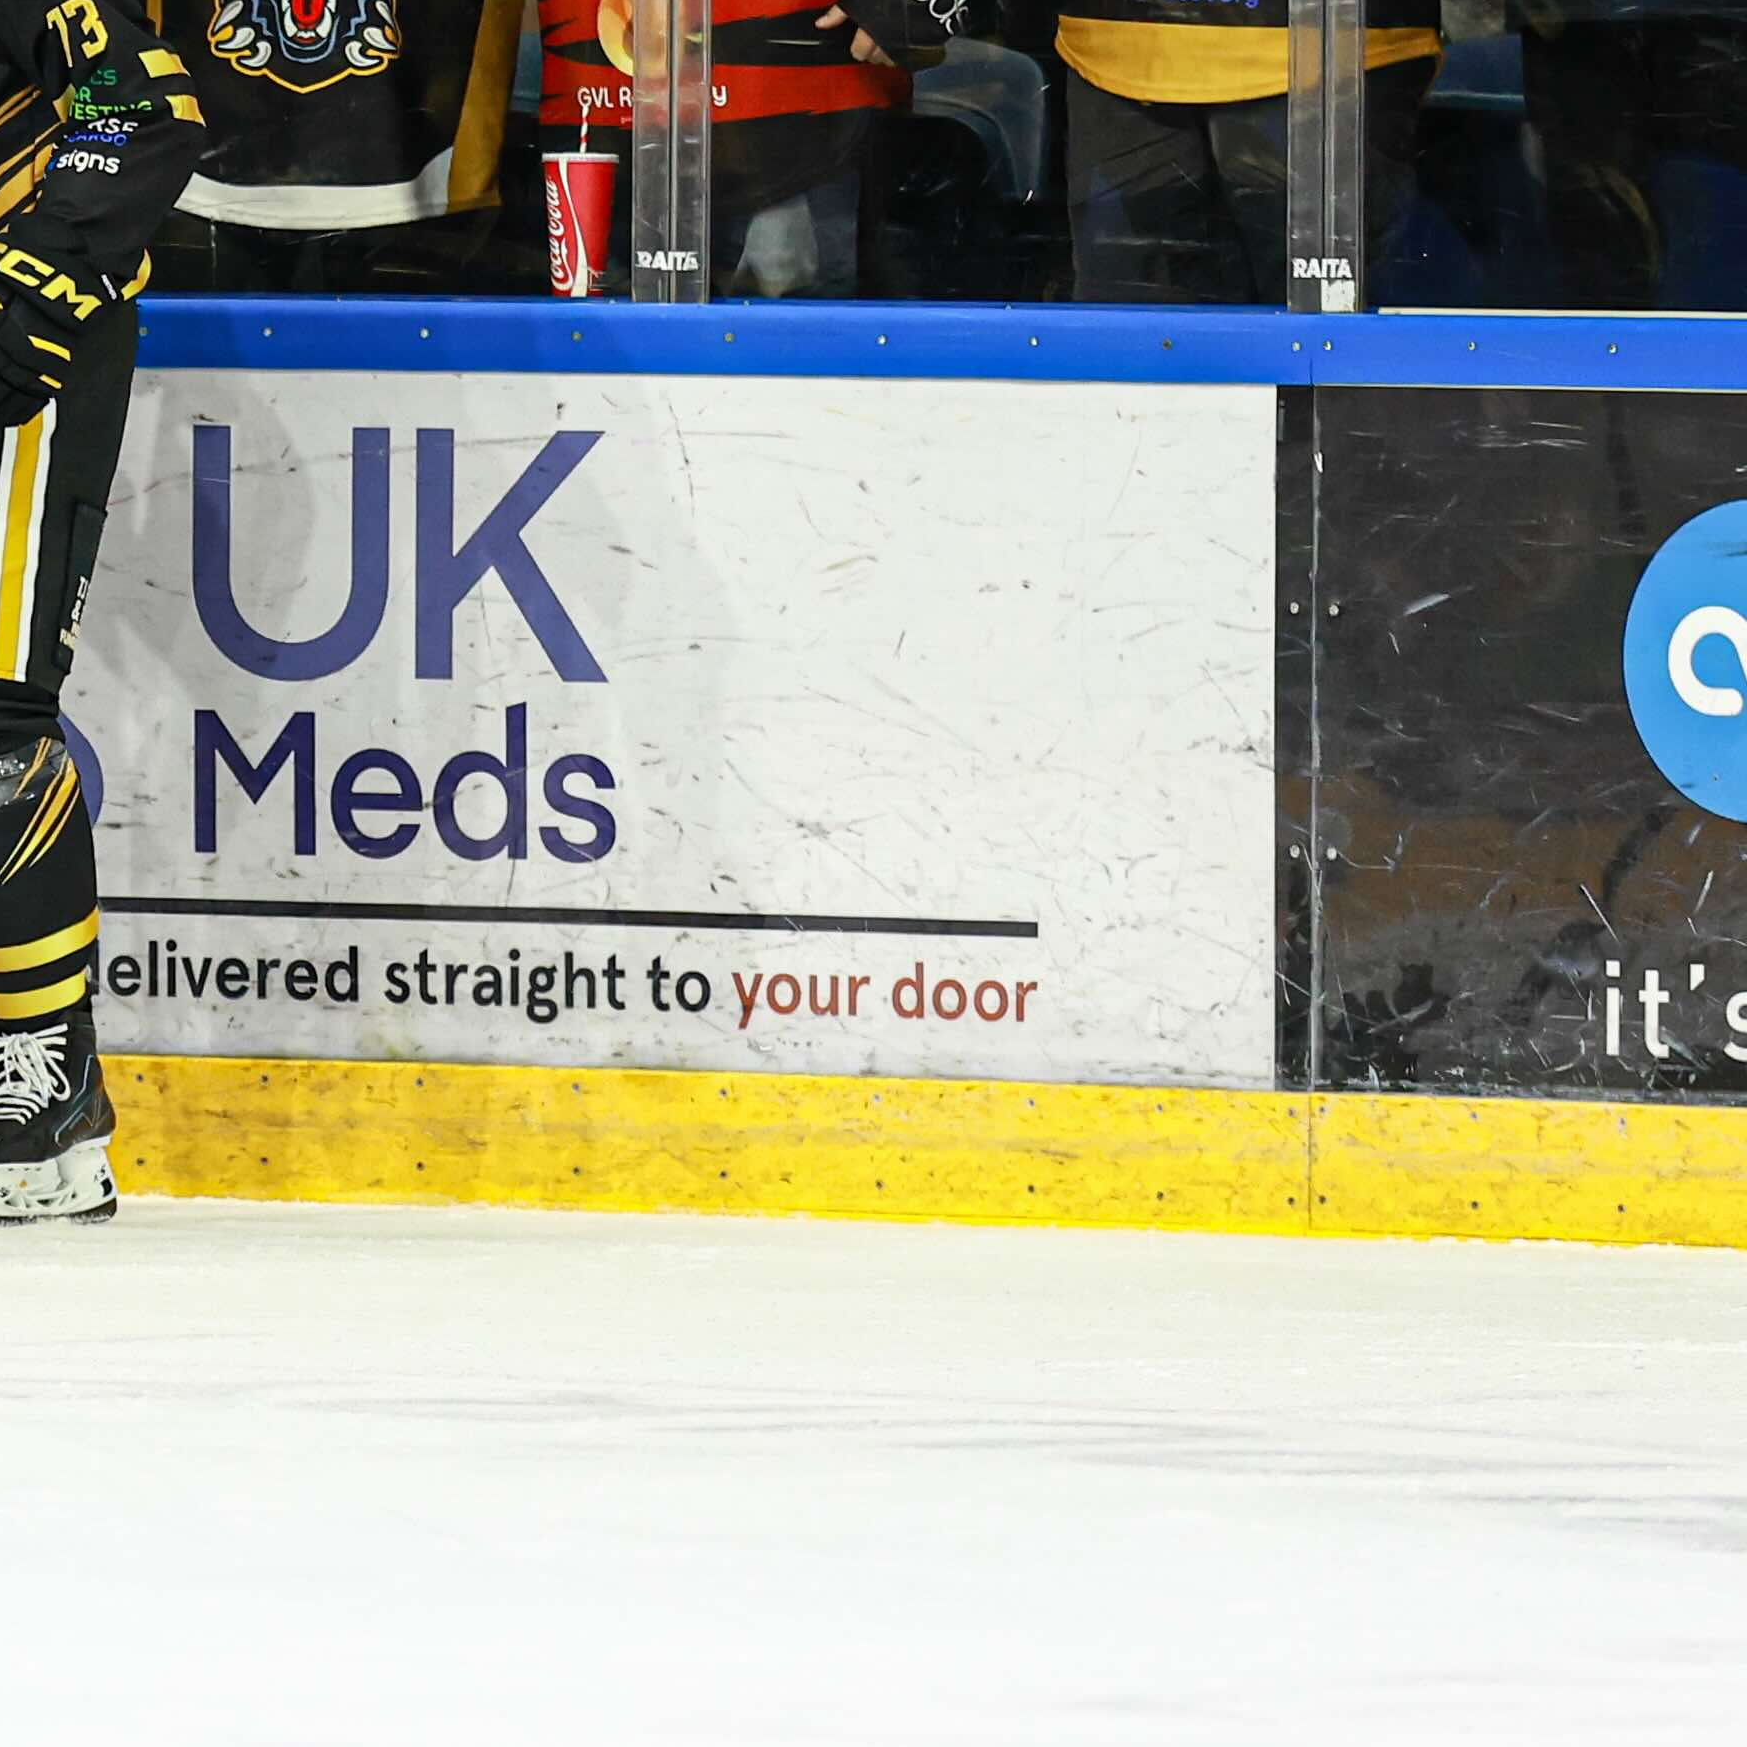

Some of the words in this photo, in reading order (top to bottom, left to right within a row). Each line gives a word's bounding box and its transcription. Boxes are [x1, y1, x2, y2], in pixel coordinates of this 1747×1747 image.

[635, 250, 700, 272] RAITA
[1293, 257, 1354, 280] RAITA
[191, 424, 608, 683] UK
[193, 702, 617, 865] Meds
[95, 939, 360, 1005] elivered
[384, 949, 626, 1025] straight
[649, 955, 712, 1014] to
[732, 970, 872, 1029] your
[890, 961, 1039, 1025] door
